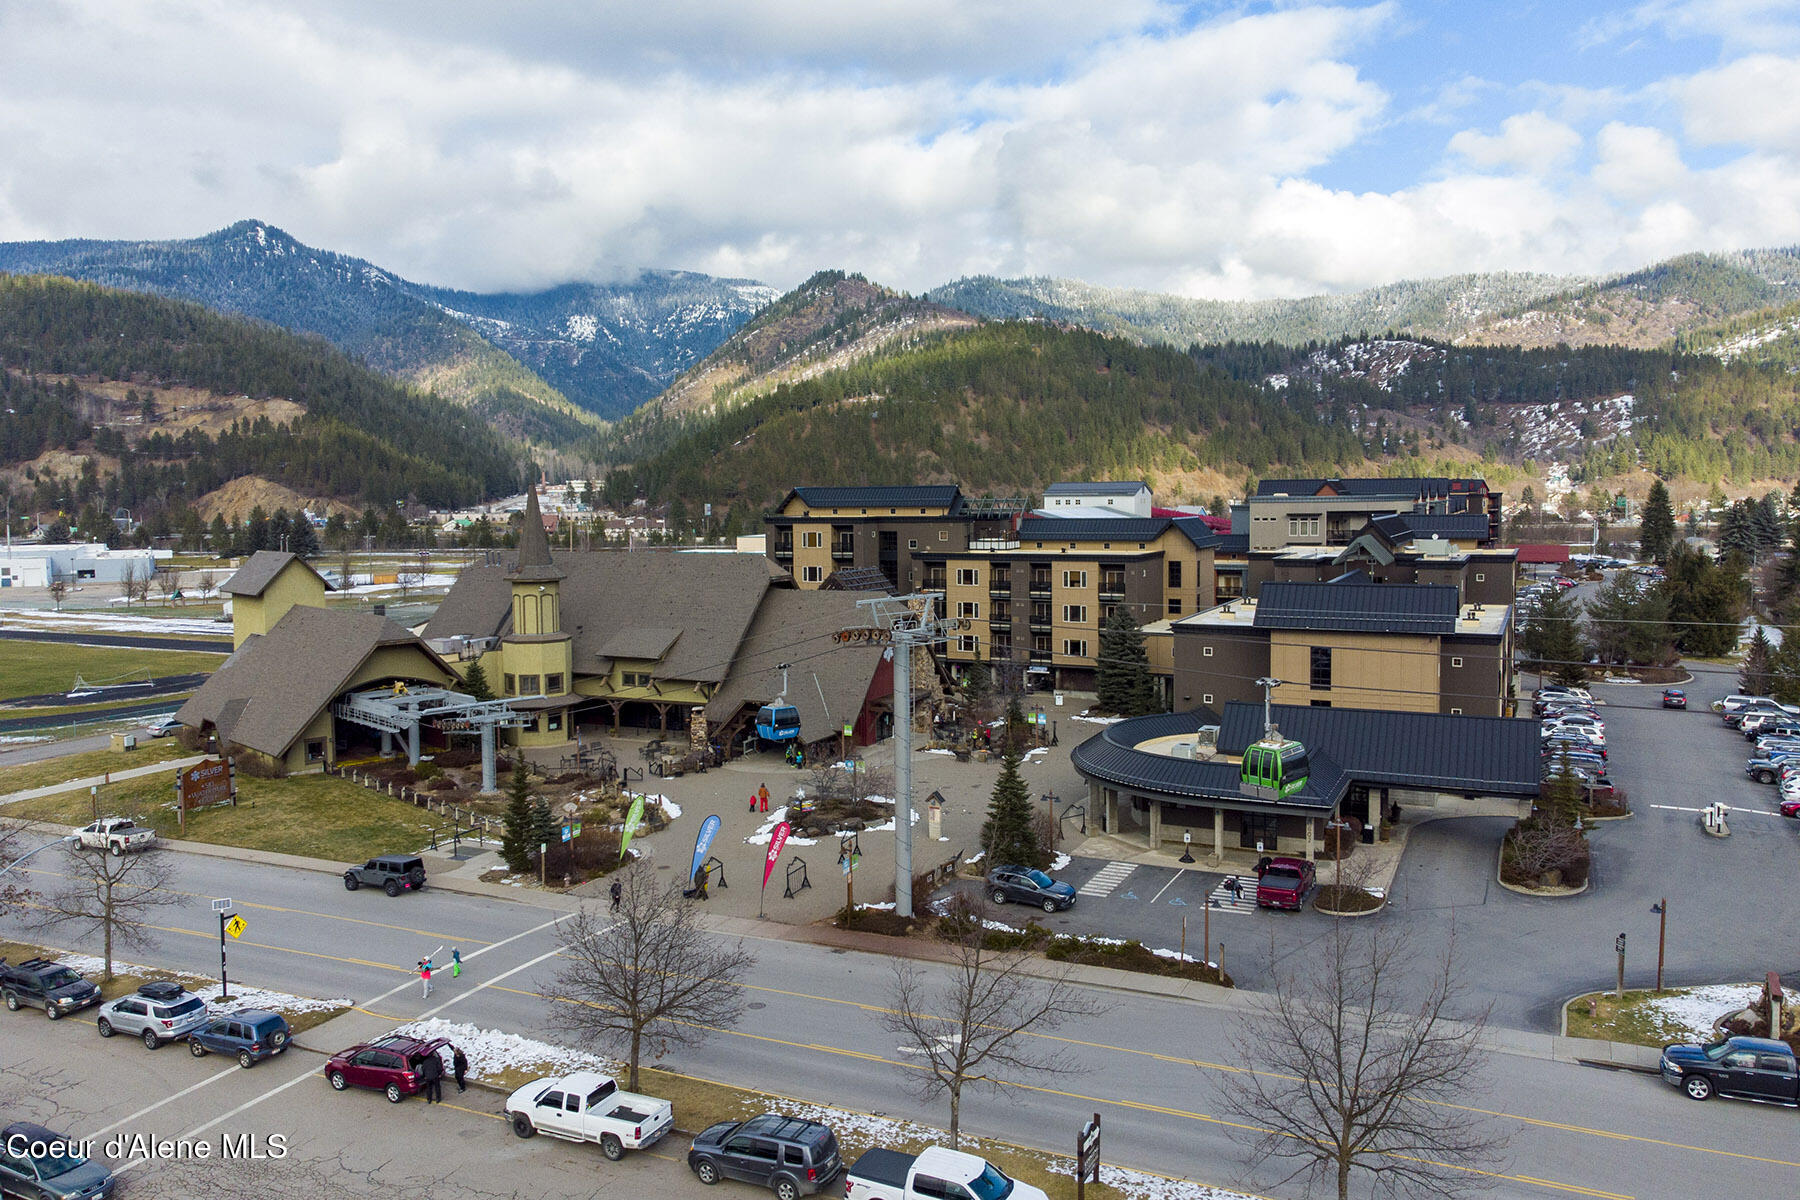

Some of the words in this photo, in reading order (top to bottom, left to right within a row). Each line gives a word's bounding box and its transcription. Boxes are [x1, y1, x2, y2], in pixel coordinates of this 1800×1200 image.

[200, 765, 223, 777] SILVER
[702, 819, 716, 842] SILVER
[772, 825, 786, 850] SILVER
